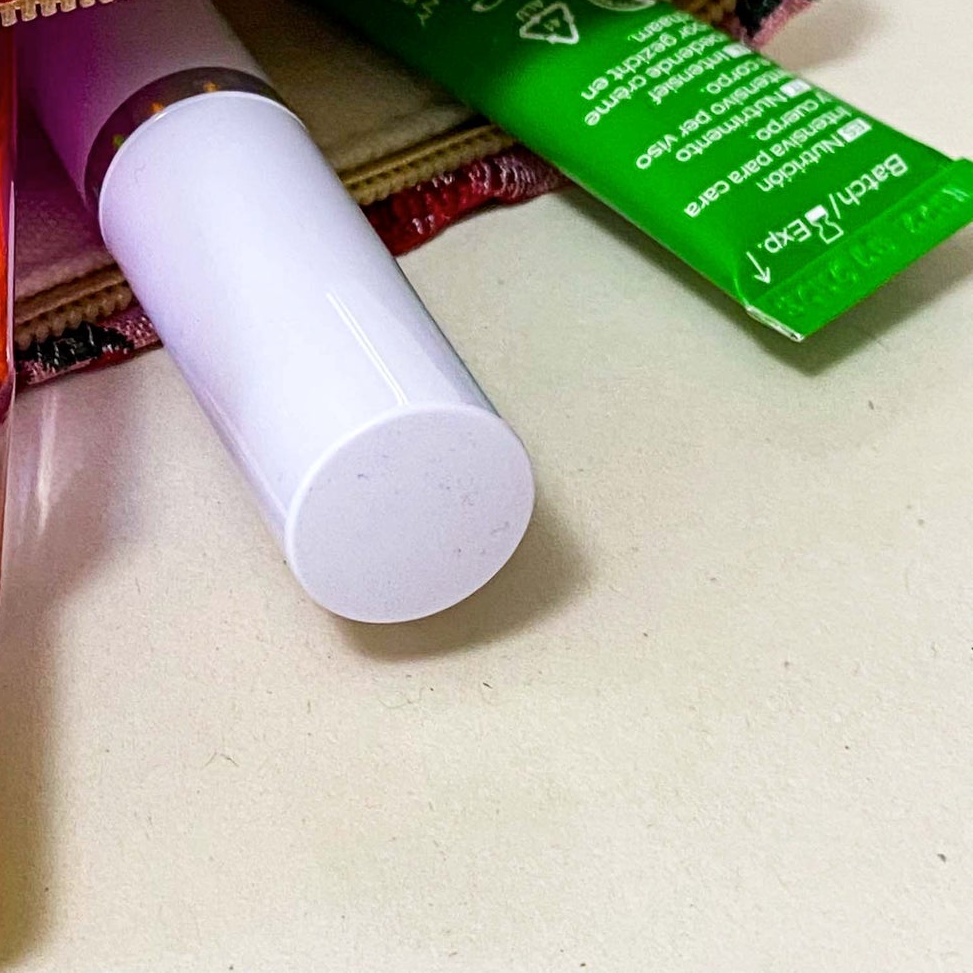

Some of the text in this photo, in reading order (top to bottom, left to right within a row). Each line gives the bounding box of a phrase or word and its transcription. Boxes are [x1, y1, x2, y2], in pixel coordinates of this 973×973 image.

[606, 33, 677, 80] gezicht
[701, 52, 759, 94] corpo.
[581, 77, 608, 100] en
[585, 75, 646, 125] crème
[676, 91, 787, 161] Nutrimento
[679, 110, 712, 137] per
[752, 99, 819, 140] cuerpo.
[636, 134, 678, 169] viso
[727, 150, 773, 184] para
[756, 131, 844, 191] Nutrición
[684, 181, 730, 217] cara
[758, 219, 811, 253] Exp.
